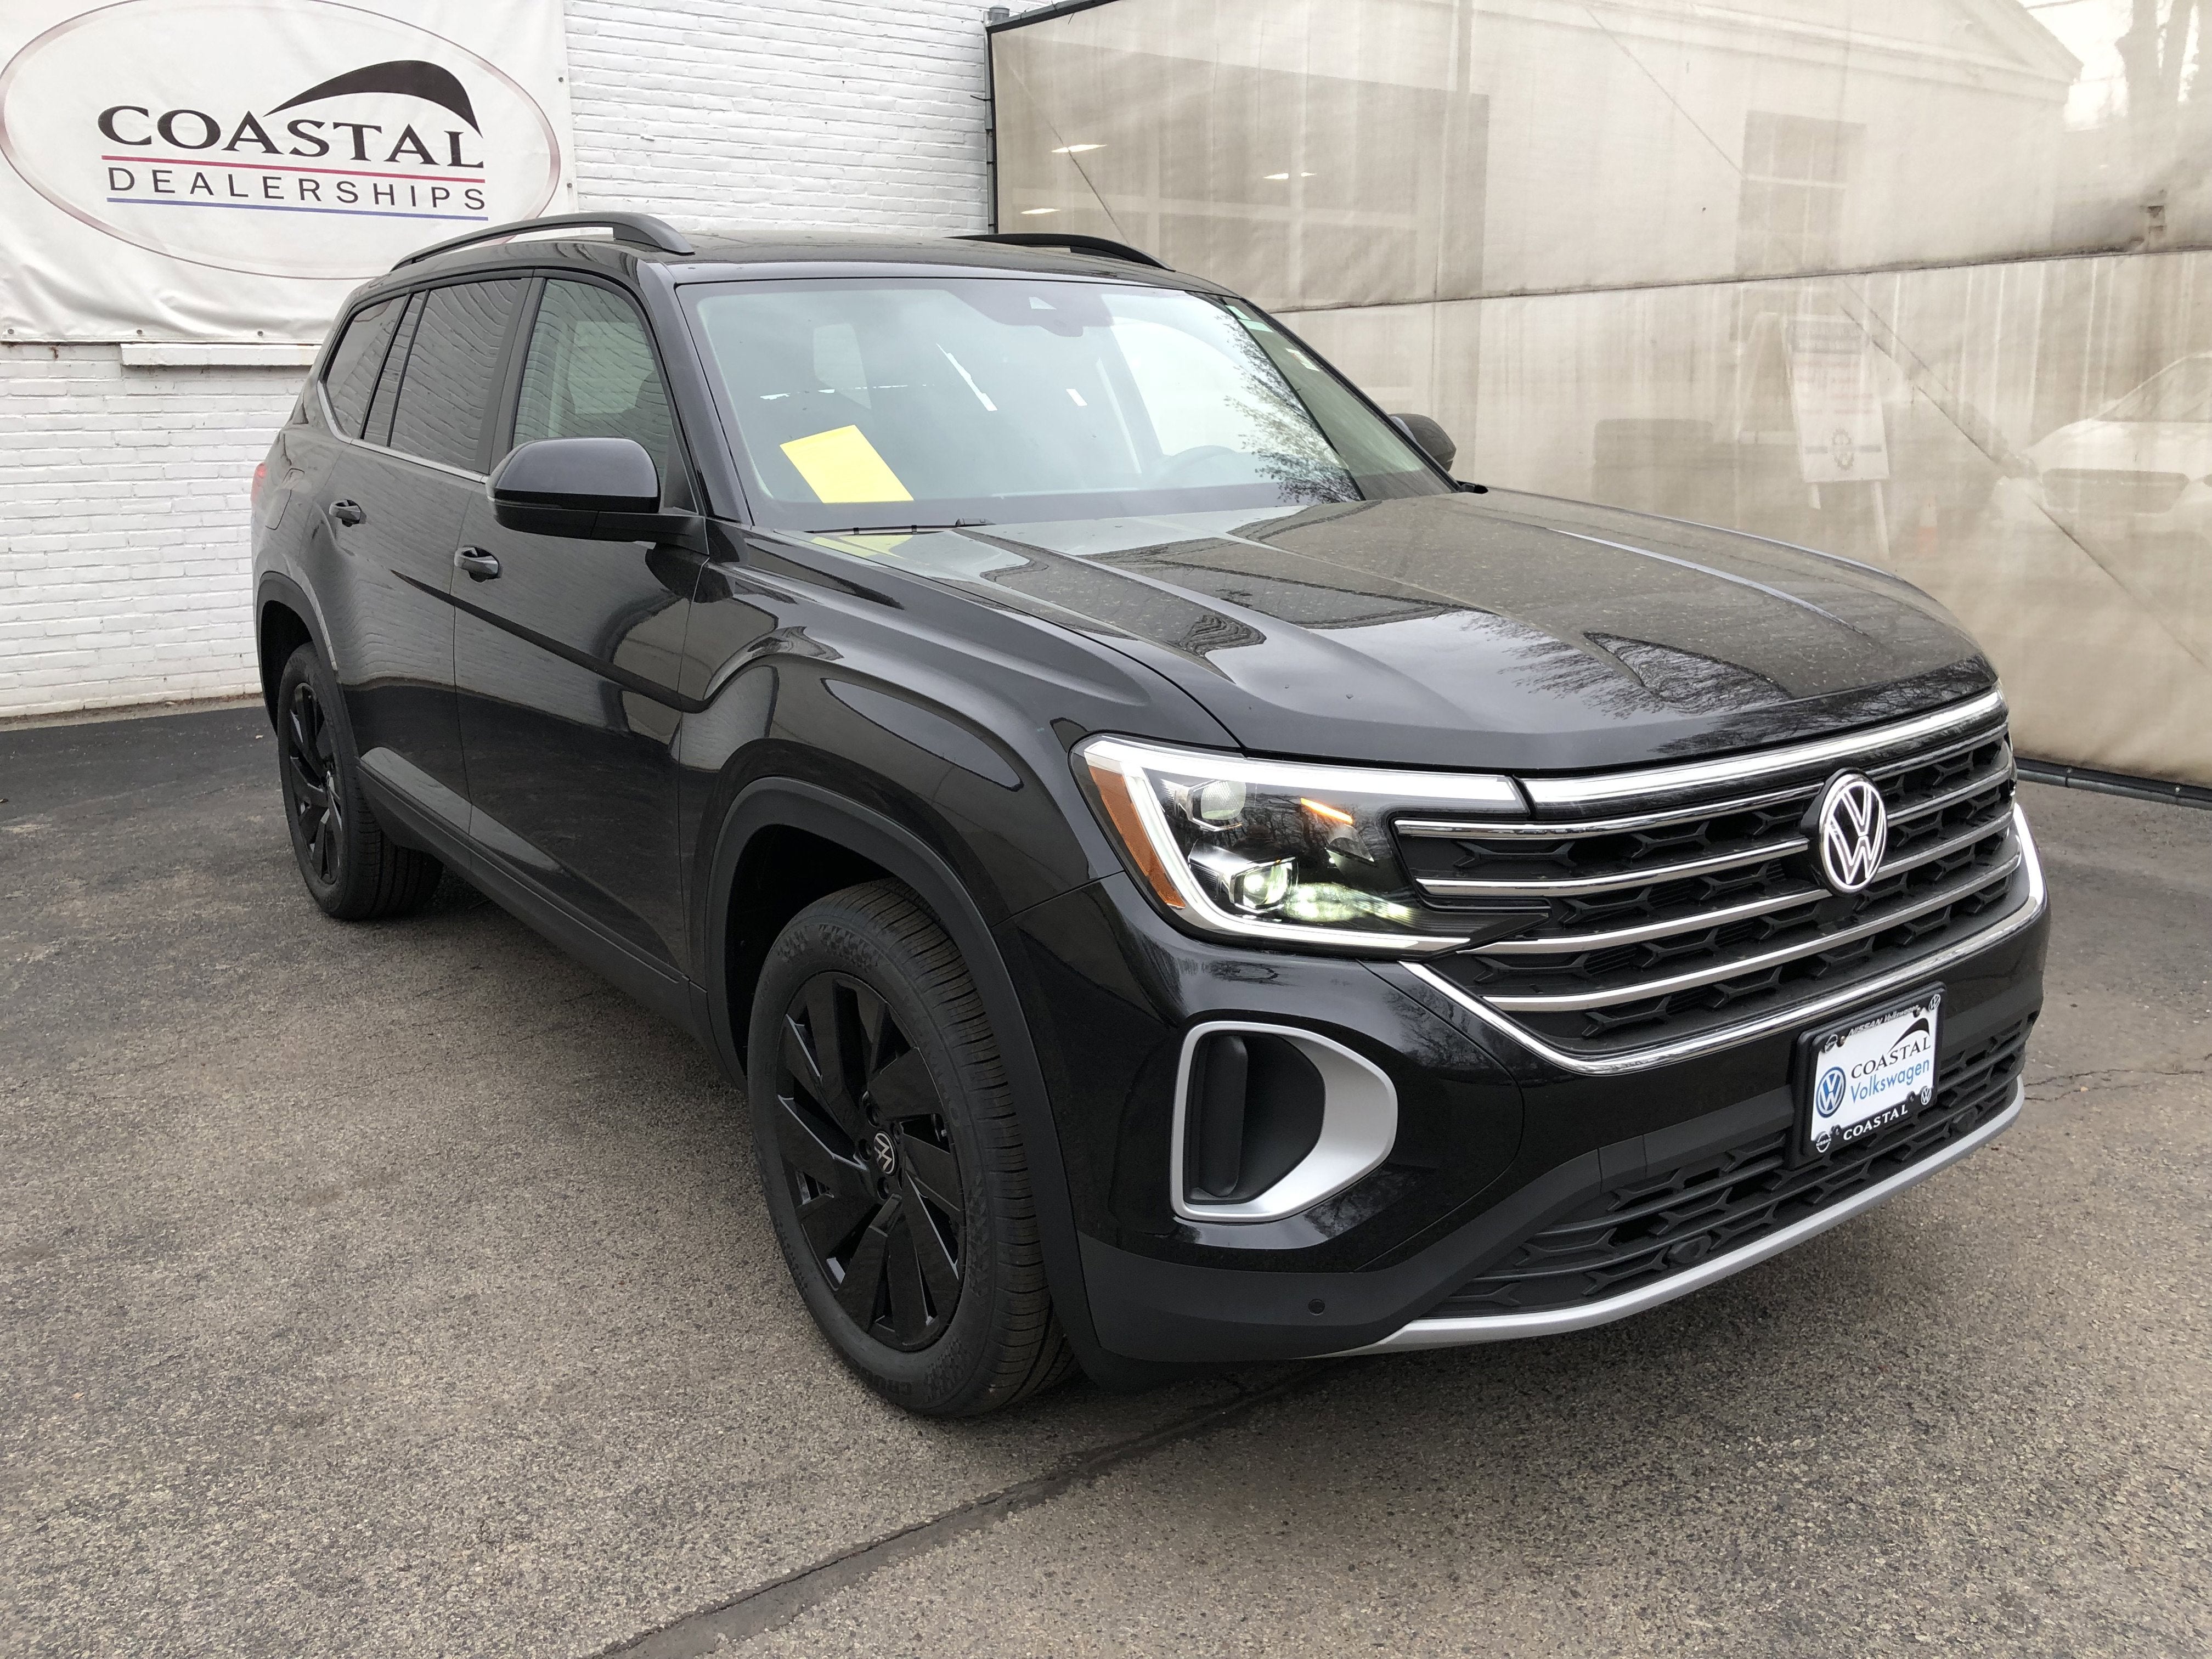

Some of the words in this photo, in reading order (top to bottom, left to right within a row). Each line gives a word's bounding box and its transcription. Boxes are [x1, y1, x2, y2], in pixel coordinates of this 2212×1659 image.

[98, 105, 484, 168] COASTAL
[108, 167, 485, 210] DEALERSHIPS
[1850, 1037, 1931, 1079] COASTAL
[1850, 1059, 1930, 1104] Volkswagen
[1843, 1104, 1909, 1141] COASTAL
